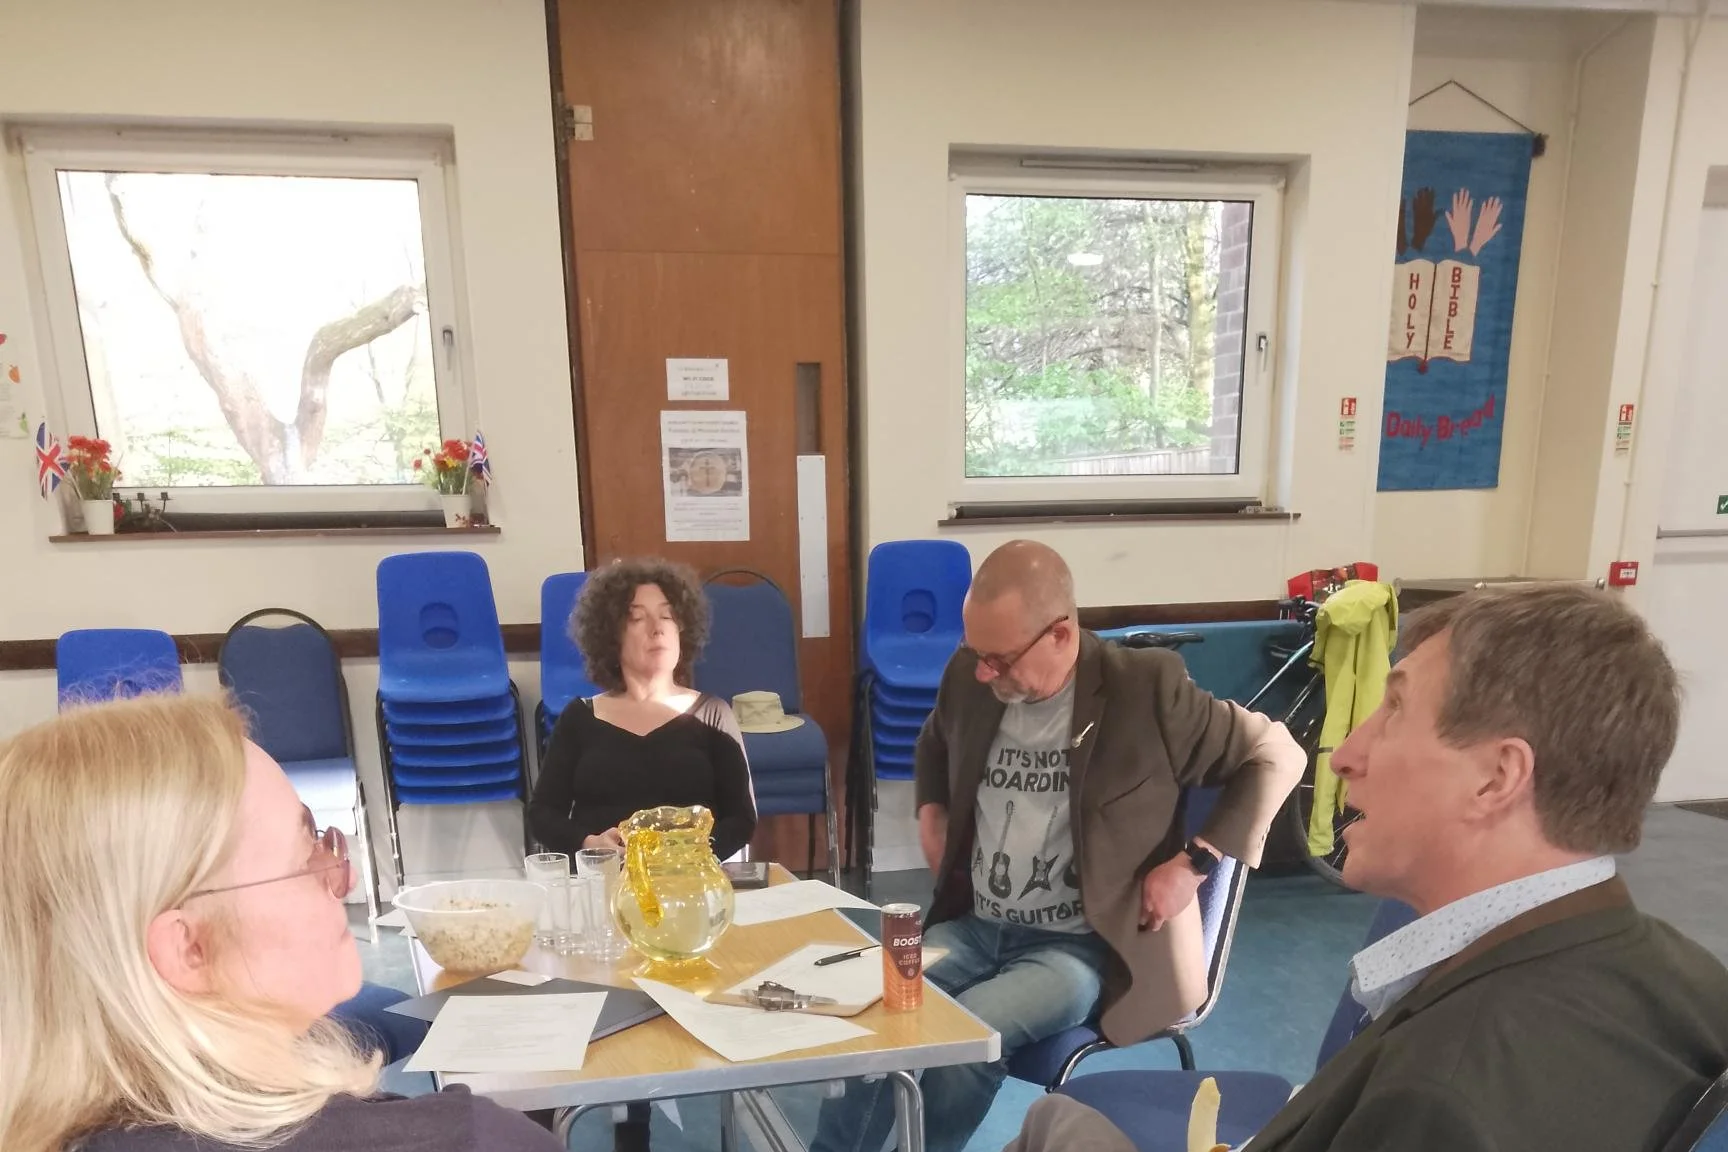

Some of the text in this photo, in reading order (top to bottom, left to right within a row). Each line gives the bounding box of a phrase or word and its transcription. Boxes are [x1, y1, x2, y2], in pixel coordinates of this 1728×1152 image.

[1406, 273, 1420, 349] HOLY
[1443, 267, 1462, 350] BIBLE
[1385, 411, 1432, 448] Daily
[1436, 392, 1496, 441] Bread
[997, 748, 1071, 769] IT'S NOT
[976, 890, 1002, 919] IT'S
